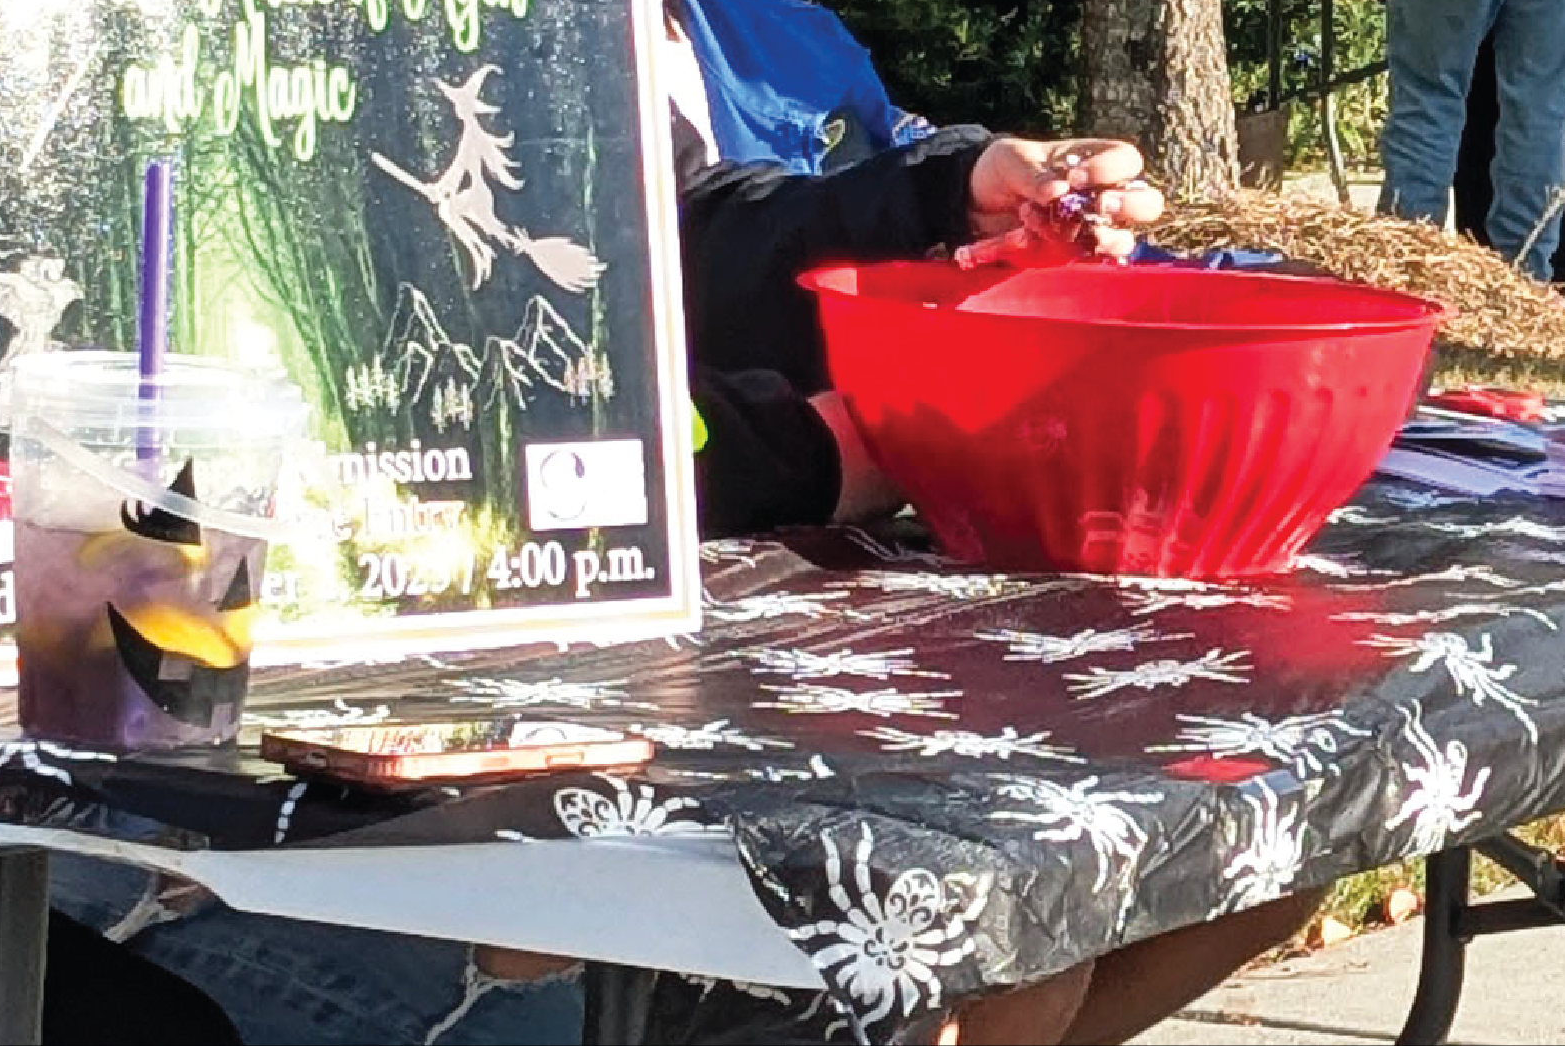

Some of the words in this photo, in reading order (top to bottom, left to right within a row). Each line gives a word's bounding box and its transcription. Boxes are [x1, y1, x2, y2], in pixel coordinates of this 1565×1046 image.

[122, 21, 204, 134] and
[212, 10, 358, 163] Magic
[487, 540, 566, 591] 4:00
[573, 542, 656, 598] p.m.
